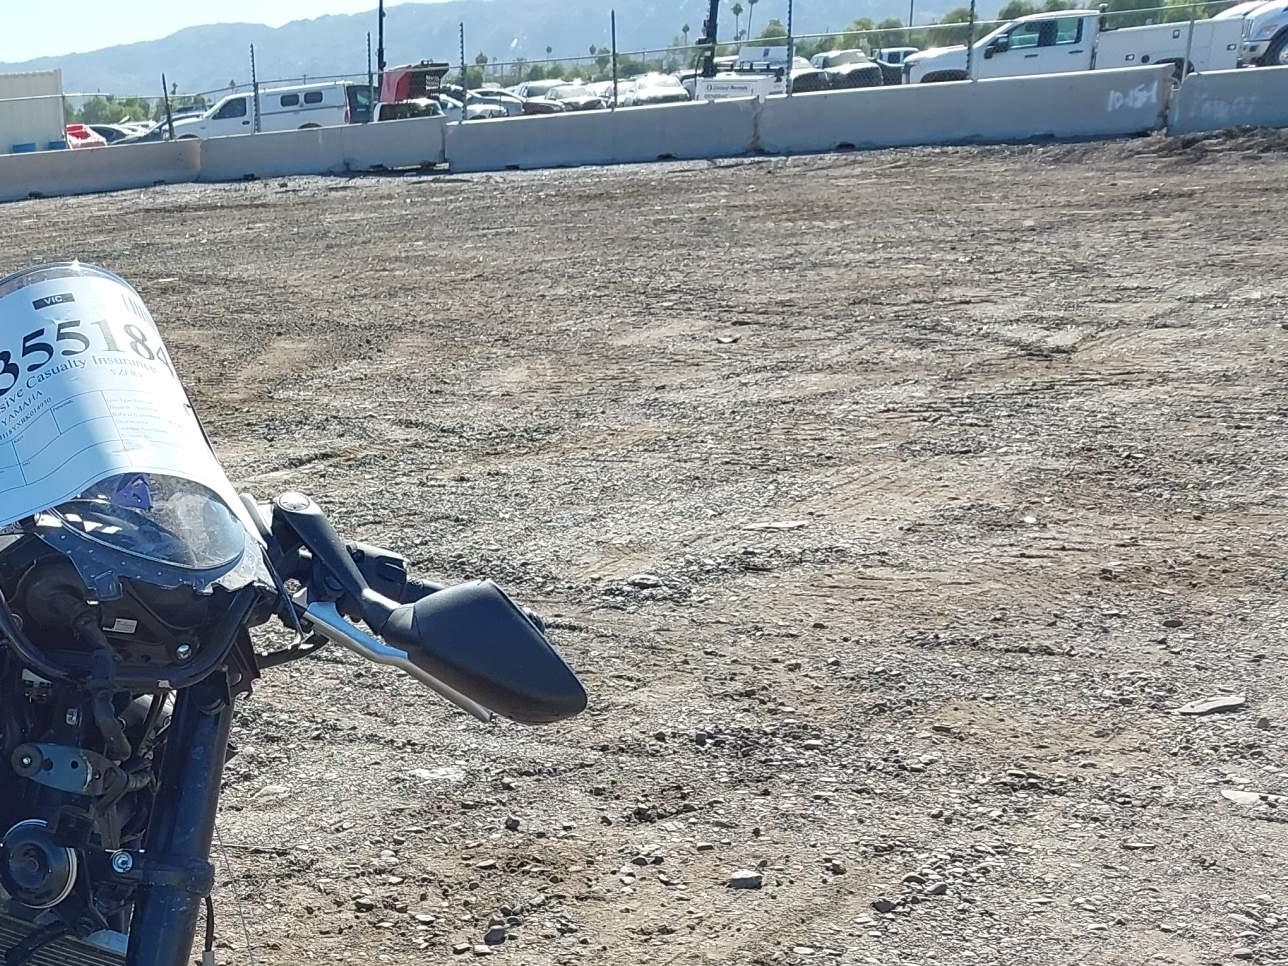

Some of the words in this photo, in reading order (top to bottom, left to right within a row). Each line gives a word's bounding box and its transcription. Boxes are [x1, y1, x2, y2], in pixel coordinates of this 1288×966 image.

[43, 295, 63, 305] VIC
[26, 357, 87, 389] Casualty
[1, 390, 43, 427] YAMAHA
